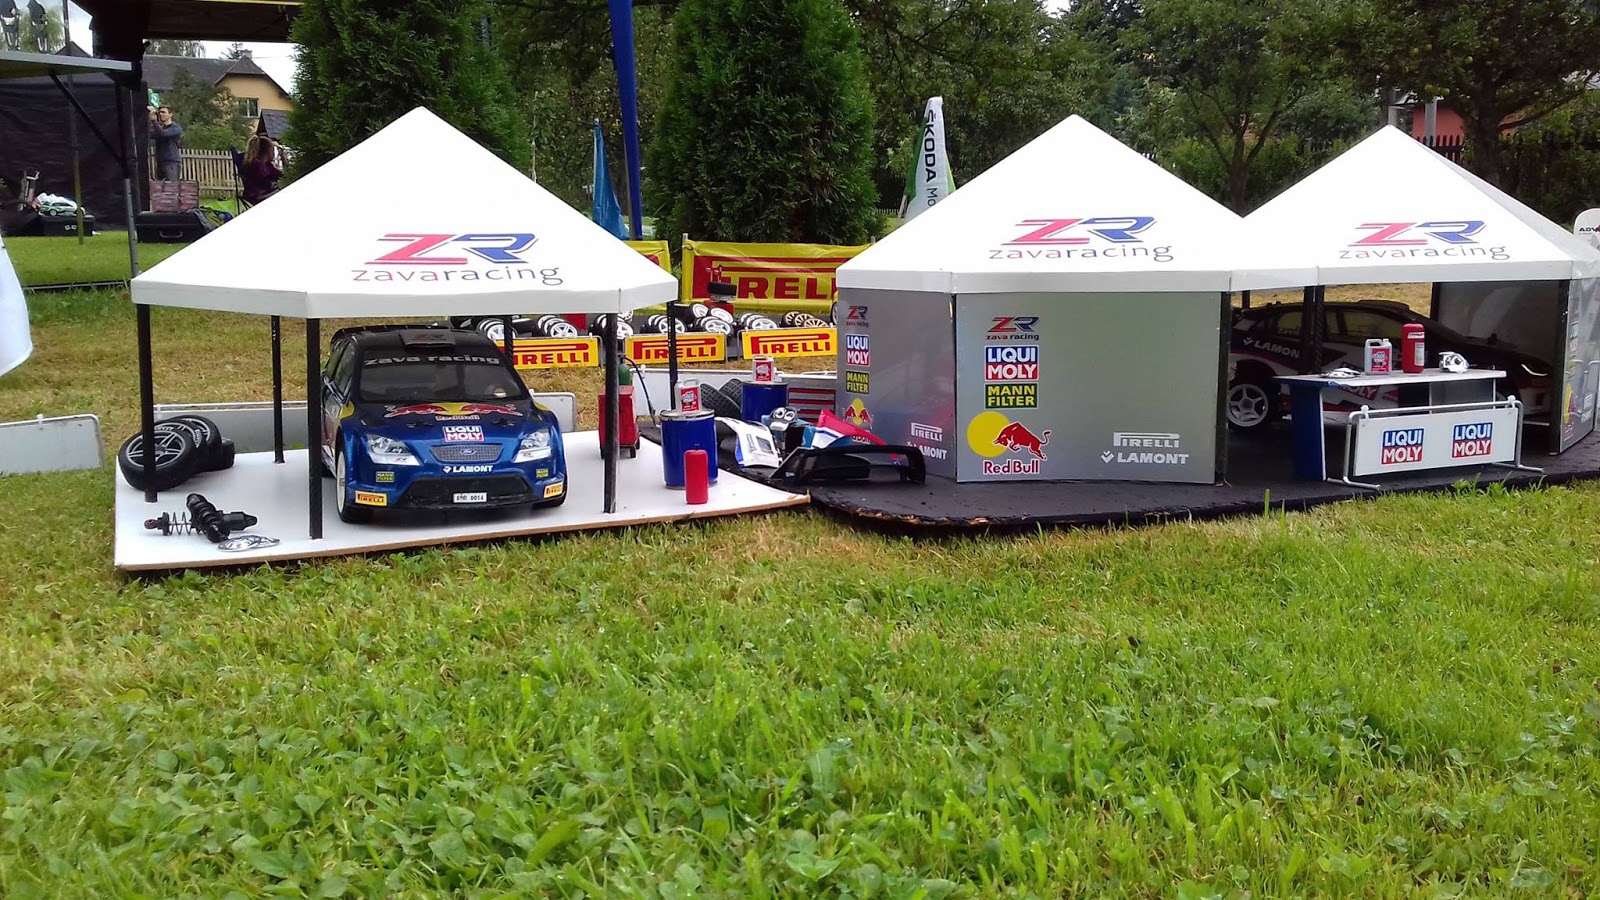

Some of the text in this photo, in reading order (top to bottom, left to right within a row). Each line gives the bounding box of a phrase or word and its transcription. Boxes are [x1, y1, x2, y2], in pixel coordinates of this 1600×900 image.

[988, 245, 1174, 263] zavaracing
[1338, 245, 1510, 261] zavaracing
[351, 266, 564, 286] zavaracing
[692, 255, 846, 299] PREL
[751, 333, 831, 354] PIRELLI
[847, 336, 868, 350] LIQUI
[1254, 340, 1300, 358] LAMON
[364, 355, 500, 366] zava racing
[847, 350, 869, 365] MOLY
[988, 348, 1036, 363] LIQUI
[847, 372, 868, 383] MANN
[988, 364, 1037, 379] MOLY
[847, 383, 868, 393] FILTER
[988, 385, 1035, 395] MANN
[988, 396, 1035, 406] FILTER
[911, 422, 942, 442] PIRELLI
[1113, 432, 1180, 448] PIRELLI
[1384, 430, 1423, 446] LIQUI
[1454, 424, 1491, 440] LIQUI
[914, 443, 947, 460] AMONT
[1383, 447, 1422, 463] MOLY
[1453, 440, 1491, 456] MOLY
[1117, 452, 1189, 464] LAMONT
[984, 461, 1039, 474] Red Bull
